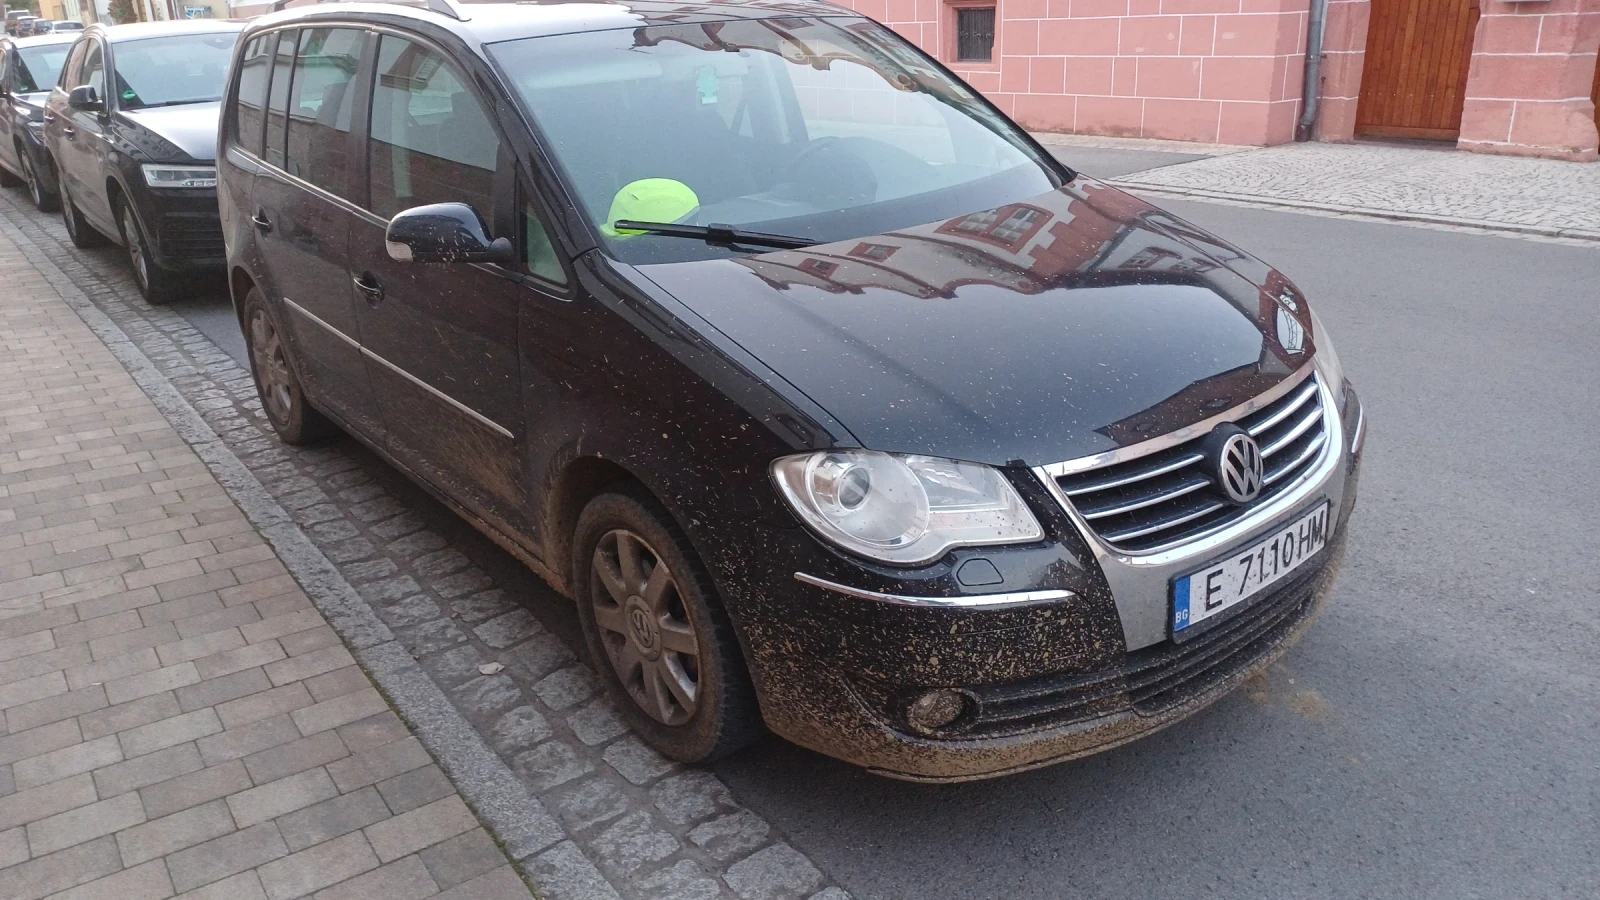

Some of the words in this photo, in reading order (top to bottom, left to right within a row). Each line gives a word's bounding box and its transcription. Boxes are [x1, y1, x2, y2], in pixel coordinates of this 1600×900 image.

[1222, 434, 1263, 502] VW
[1206, 568, 1223, 612] E
[1238, 532, 1294, 596] 7110
[1298, 510, 1324, 560] HM
[1175, 609, 1188, 623] BG
